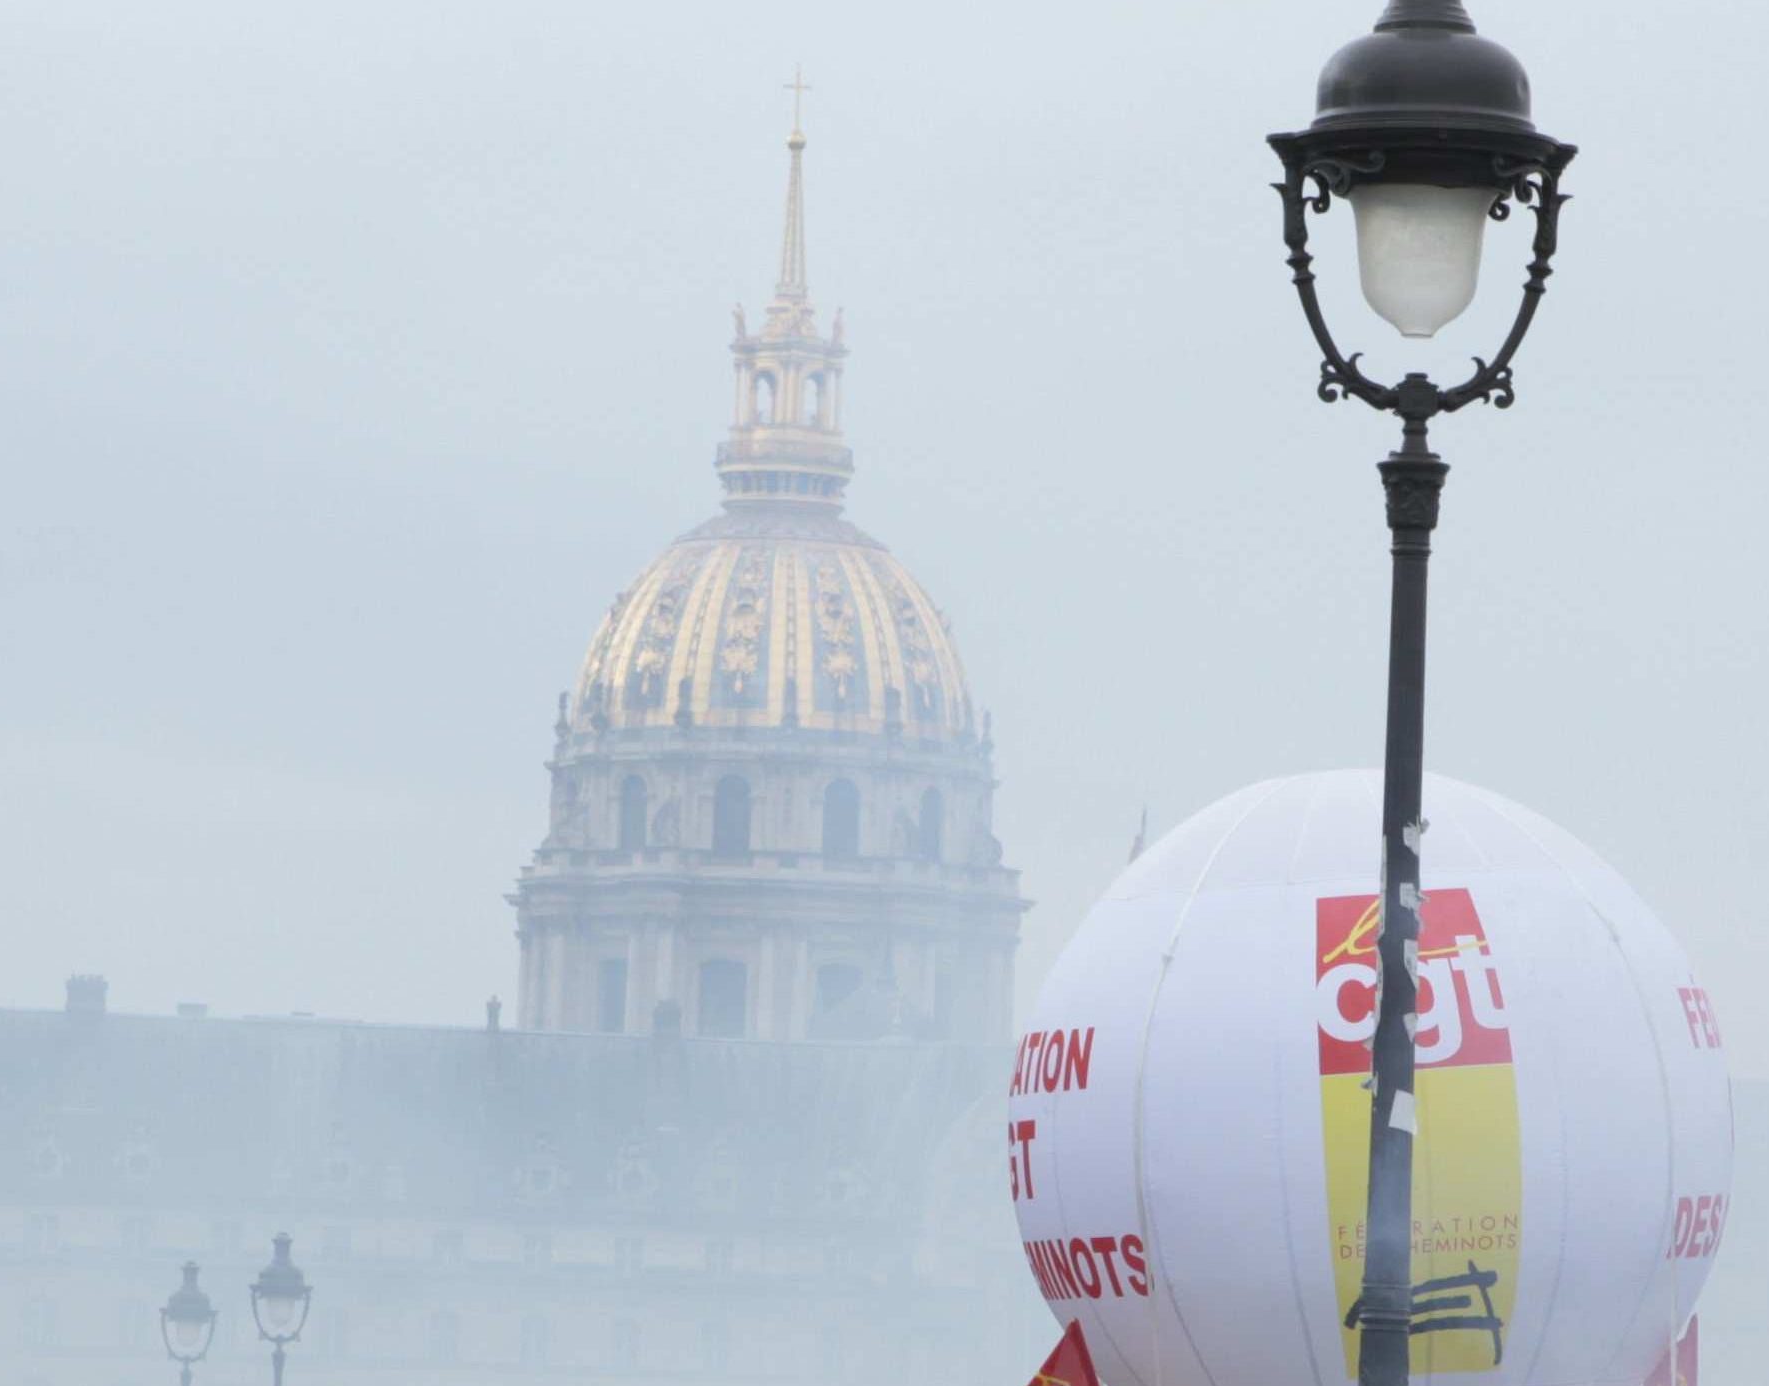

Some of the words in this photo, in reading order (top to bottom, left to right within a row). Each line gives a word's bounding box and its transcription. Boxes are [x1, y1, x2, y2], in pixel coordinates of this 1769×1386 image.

[1316, 935, 1509, 1063] cgt
[1338, 1214, 1519, 1241] FÉRATION
[1411, 1233, 1518, 1254] HEMINOTS
